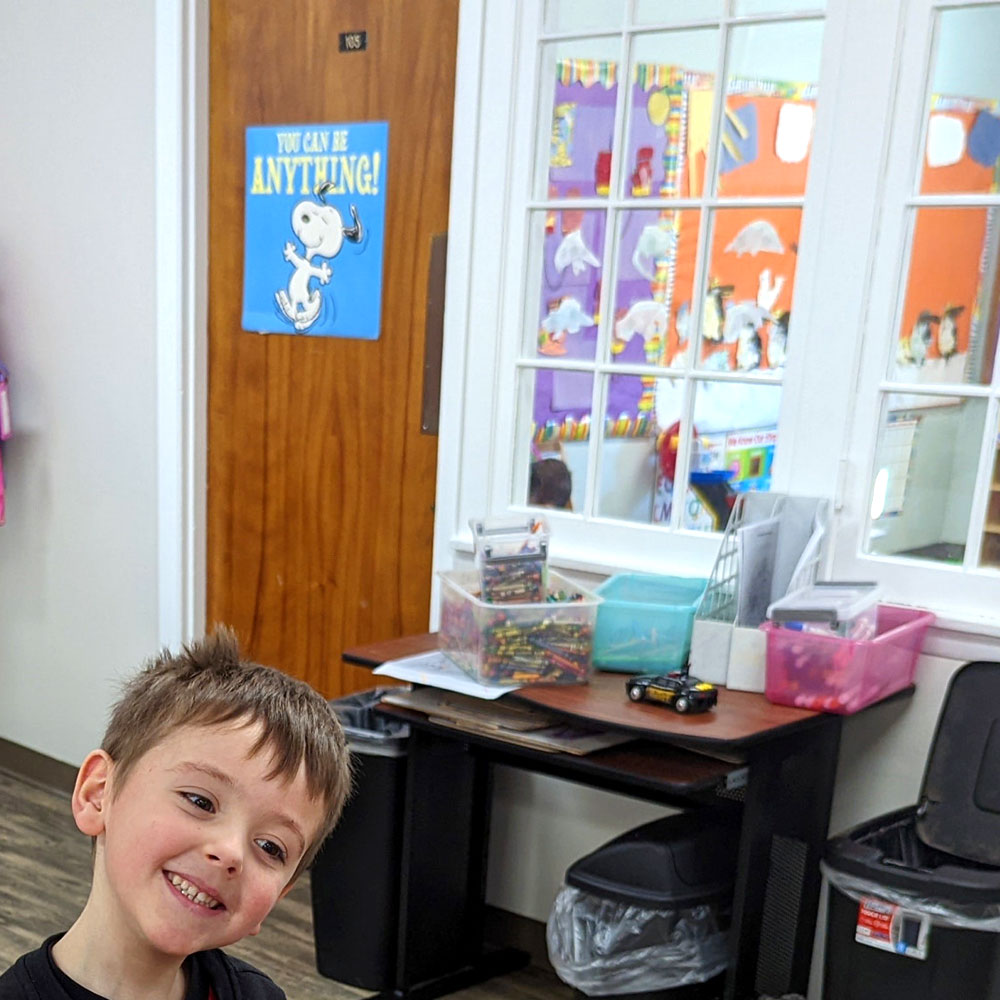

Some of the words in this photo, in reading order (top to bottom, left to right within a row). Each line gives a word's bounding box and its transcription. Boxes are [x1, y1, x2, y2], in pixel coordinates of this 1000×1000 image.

[277, 132, 301, 153] YOU
[302, 131, 329, 152] CAN
[332, 130, 349, 152] BE
[250, 151, 381, 195] ANYTHING!
